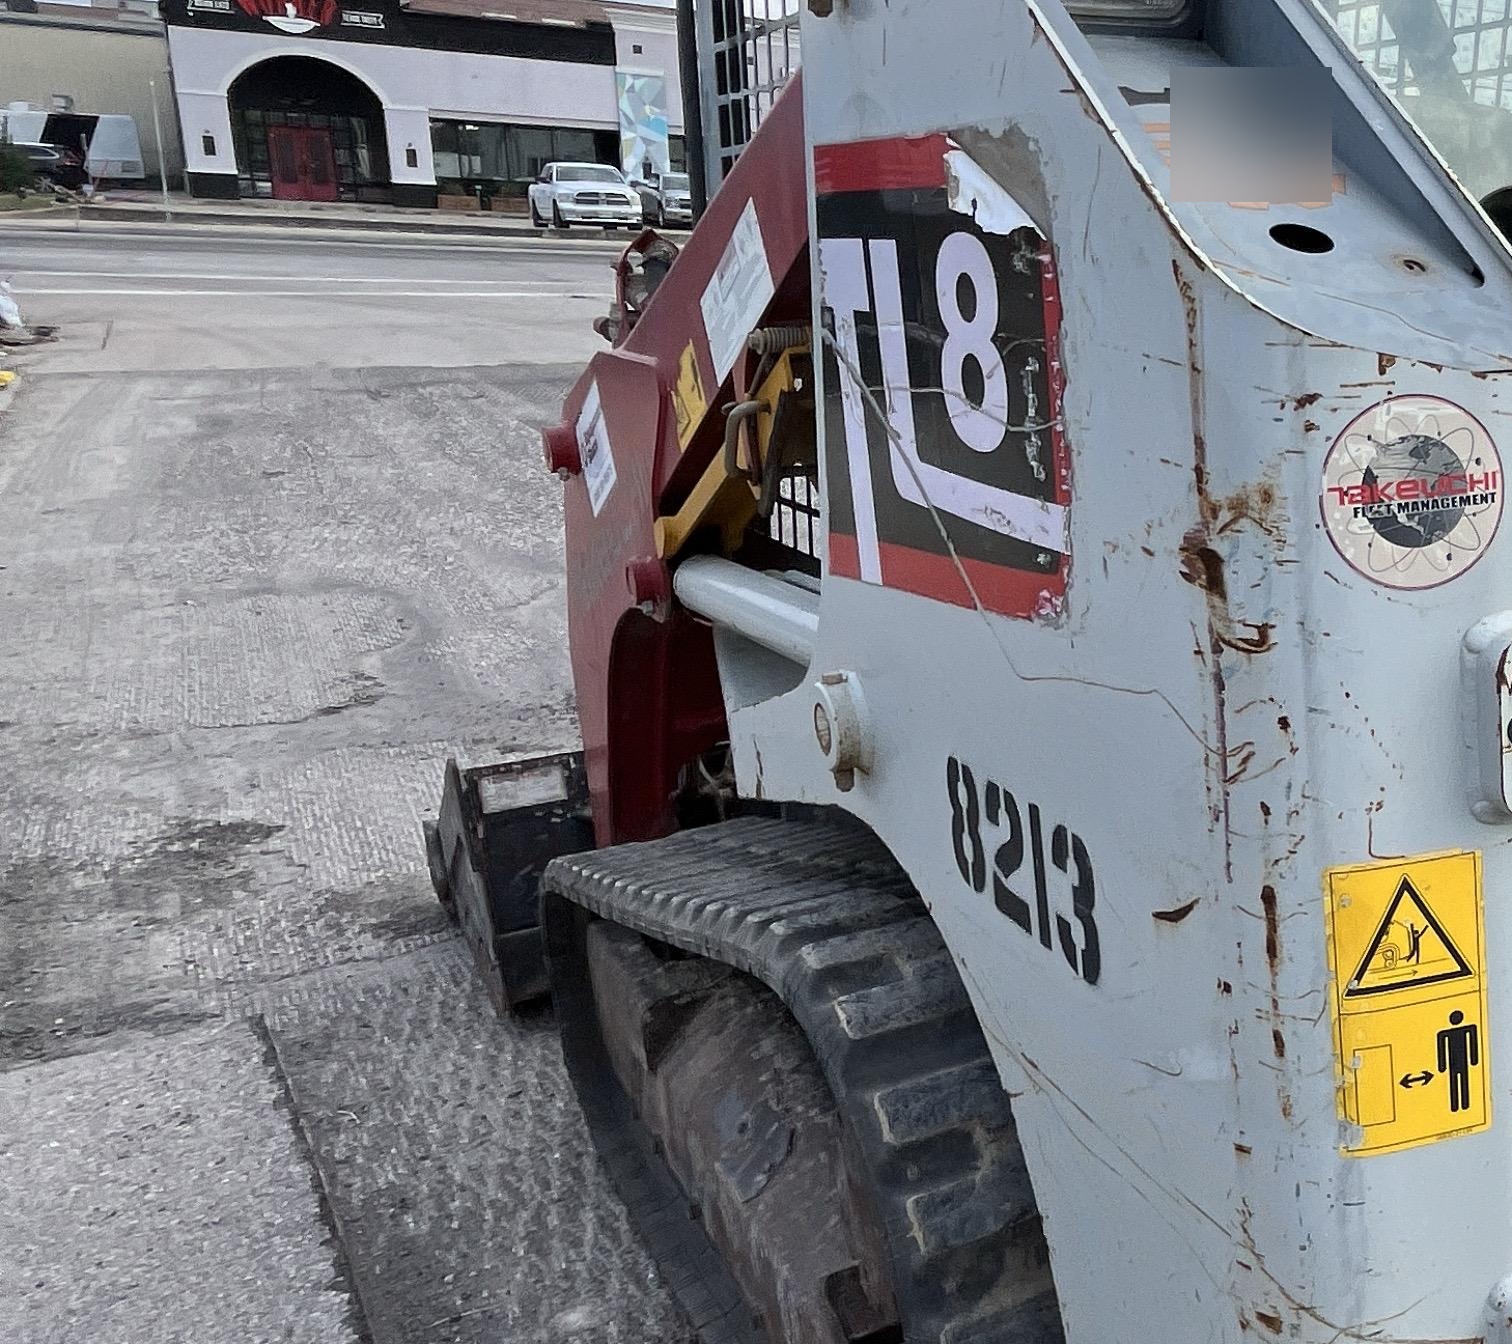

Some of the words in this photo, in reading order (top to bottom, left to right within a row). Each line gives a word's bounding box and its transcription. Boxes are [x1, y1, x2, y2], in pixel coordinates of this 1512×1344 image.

[819, 231, 1071, 586] TL8
[1397, 491, 1497, 514] MANAGEMENT
[945, 755, 1102, 986] 8213
